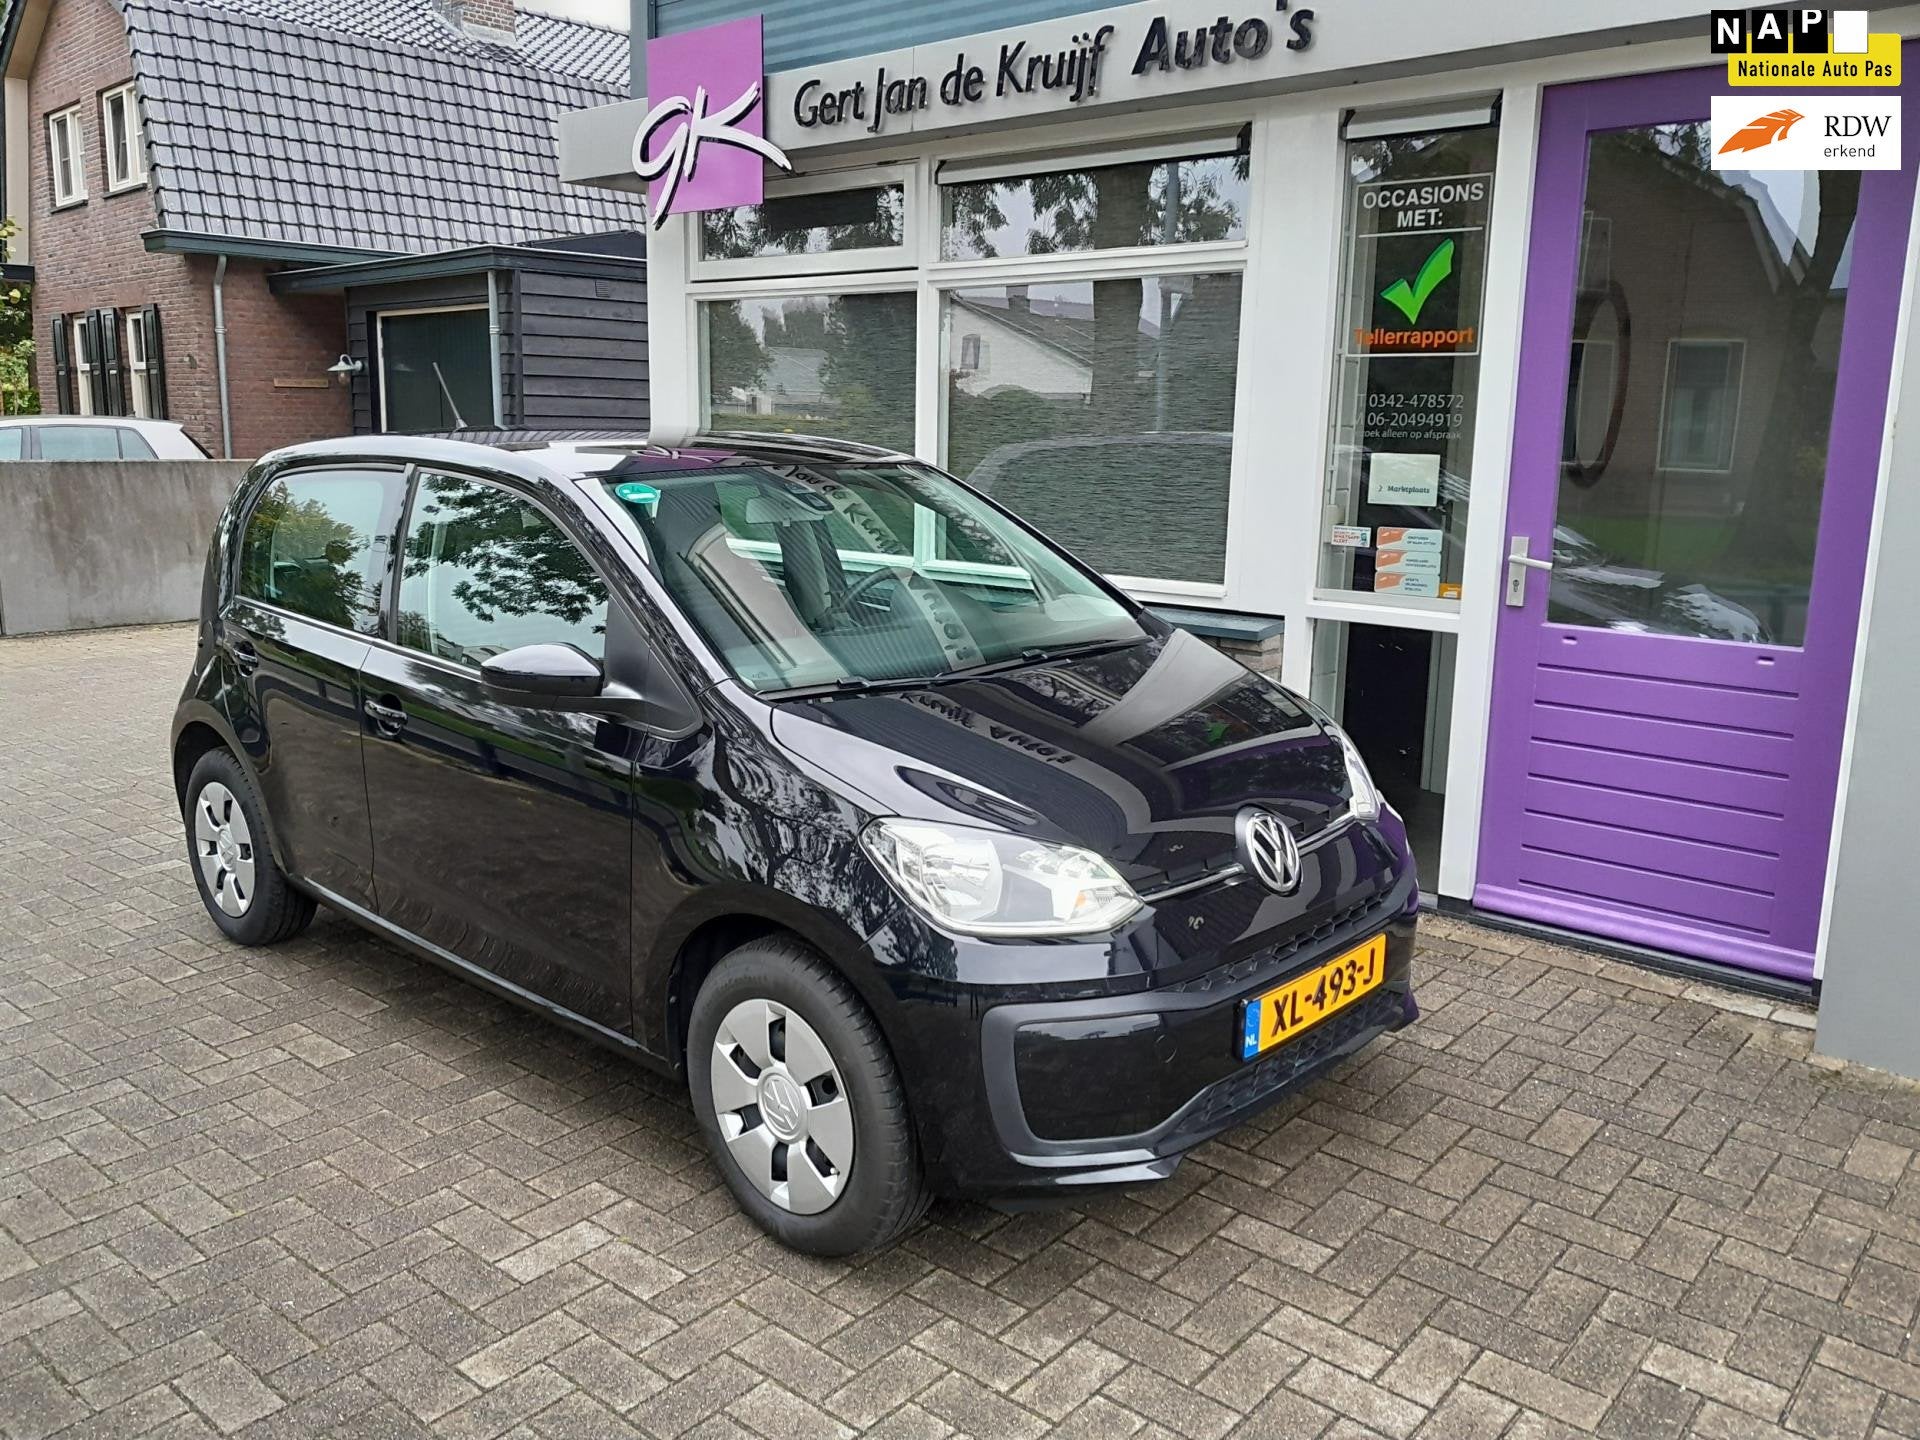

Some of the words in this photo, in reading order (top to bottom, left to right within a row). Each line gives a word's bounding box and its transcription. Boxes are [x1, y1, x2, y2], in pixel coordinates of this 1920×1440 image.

[793, 79, 865, 128] Gert
[867, 67, 928, 133] Jan
[940, 53, 985, 106] de
[995, 25, 1115, 102] Kruijf
[1131, 0, 1316, 76] Auto's
[1363, 182, 1484, 209] OCCASIONS
[1396, 208, 1444, 228] MET:
[1355, 327, 1474, 348] Tellerrapport
[1368, 393, 1465, 409] 0342-478572
[1367, 412, 1463, 427] 06-20494919
[1381, 428, 1408, 438] alleen
[1410, 430, 1422, 440] op
[1271, 947, 1376, 1038] XL-493-J
[1245, 1035, 1258, 1047] NL
